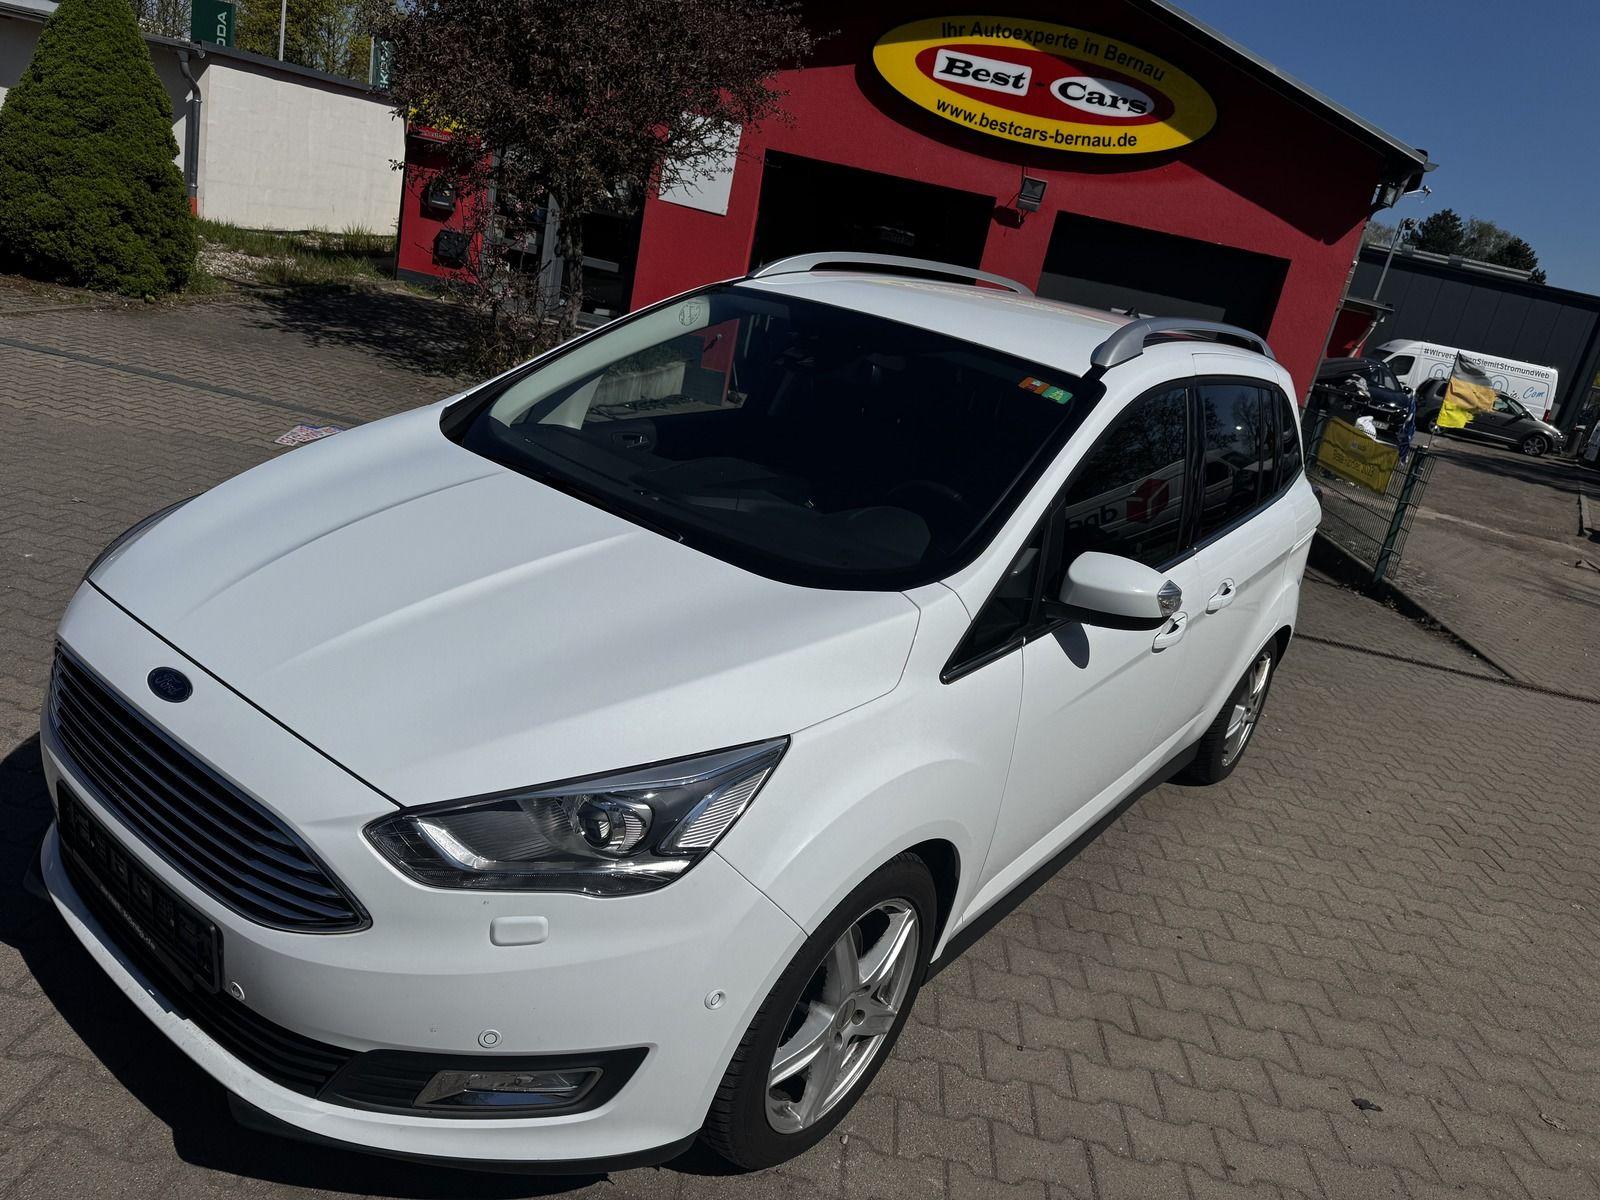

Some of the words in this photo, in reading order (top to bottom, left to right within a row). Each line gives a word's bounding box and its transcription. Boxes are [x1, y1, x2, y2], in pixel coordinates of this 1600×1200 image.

[941, 22, 966, 38] Ihr
[969, 22, 1078, 51] Autoexperte
[1084, 38, 1100, 56] in
[1104, 43, 1166, 82] Bernau
[938, 55, 1029, 90] Best
[1057, 81, 1147, 115] Cars
[935, 98, 1138, 148] www.bestcars-bernau.de
